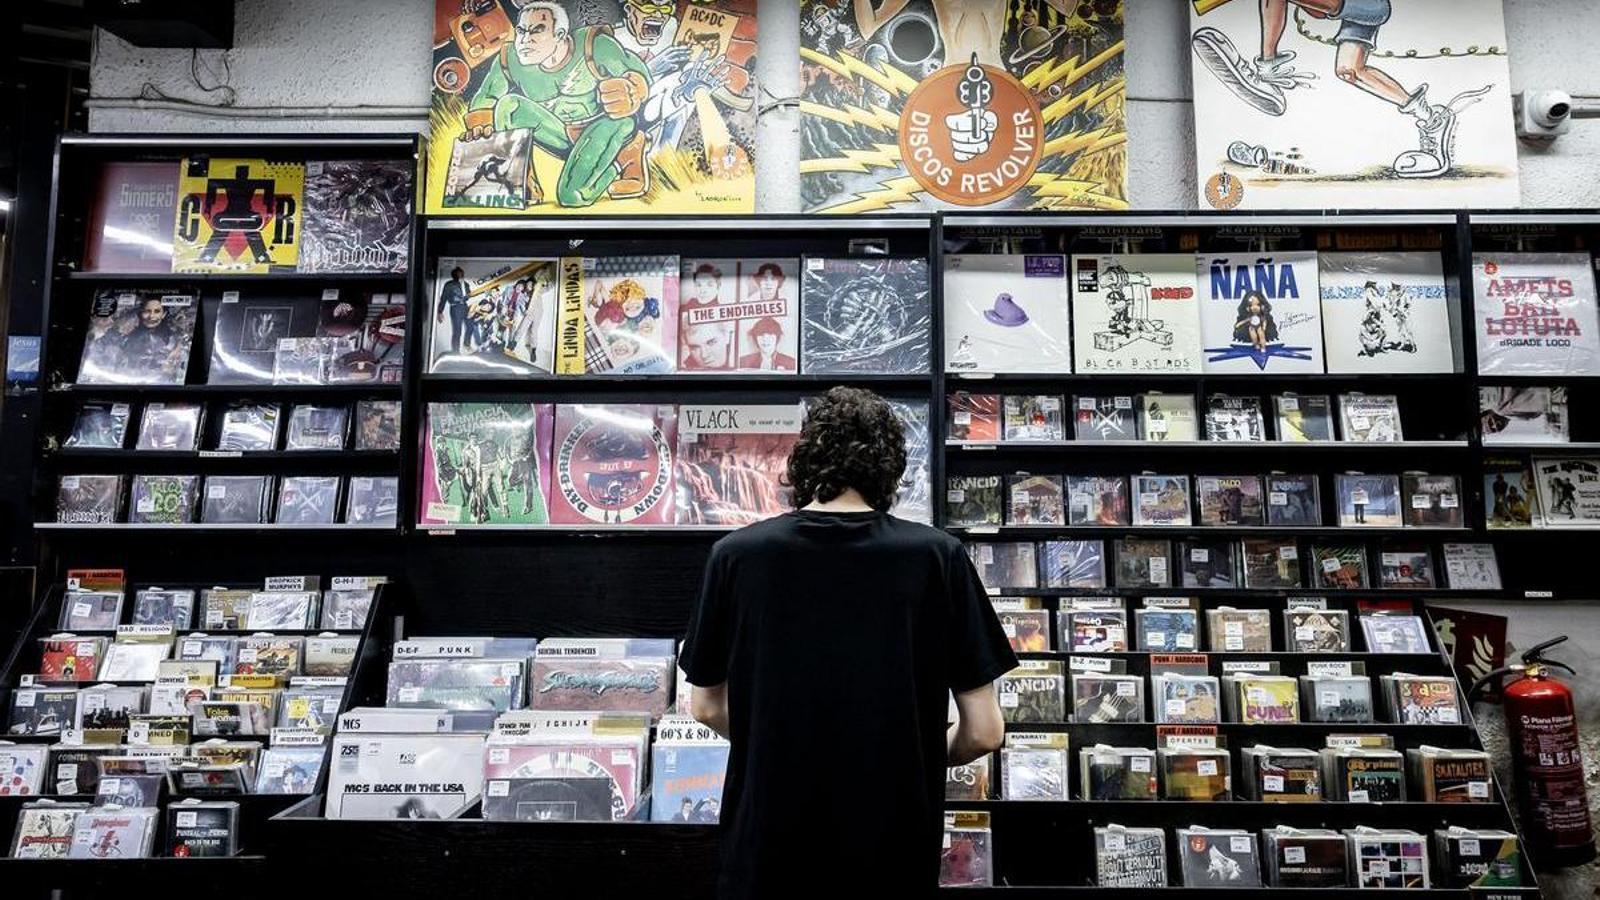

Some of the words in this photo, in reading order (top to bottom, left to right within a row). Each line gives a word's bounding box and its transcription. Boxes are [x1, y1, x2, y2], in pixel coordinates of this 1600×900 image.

[909, 110, 953, 186] DISCOS
[960, 108, 1035, 194] REVOLVER
[1209, 257, 1300, 300] ÑAÑA
[693, 309, 716, 319] THE
[719, 302, 783, 318] ENDTABLES
[1546, 338, 1571, 348] LOCO
[686, 409, 739, 429] VLACK
[563, 487, 589, 513] DAY
[269, 576, 302, 584] DROPKICK
[269, 584, 302, 592] MURPHYS
[439, 646, 471, 654] PUNK
[1153, 655, 1168, 663] PUNK
[1174, 655, 1206, 663] HARDCORE
[1001, 678, 1056, 693] RANCID
[1246, 703, 1294, 720] PUNK
[660, 728, 683, 740] 60'S
[686, 728, 694, 740] &
[697, 728, 719, 740] 80'S
[1159, 727, 1175, 736] PUNK
[1182, 727, 1216, 736] HARDCORE
[1435, 761, 1486, 777] SKATALITES
[344, 783, 370, 793] MC5
[373, 783, 401, 793] BACK
[404, 783, 416, 793] IN
[418, 783, 441, 793] THE
[443, 783, 465, 793] USA
